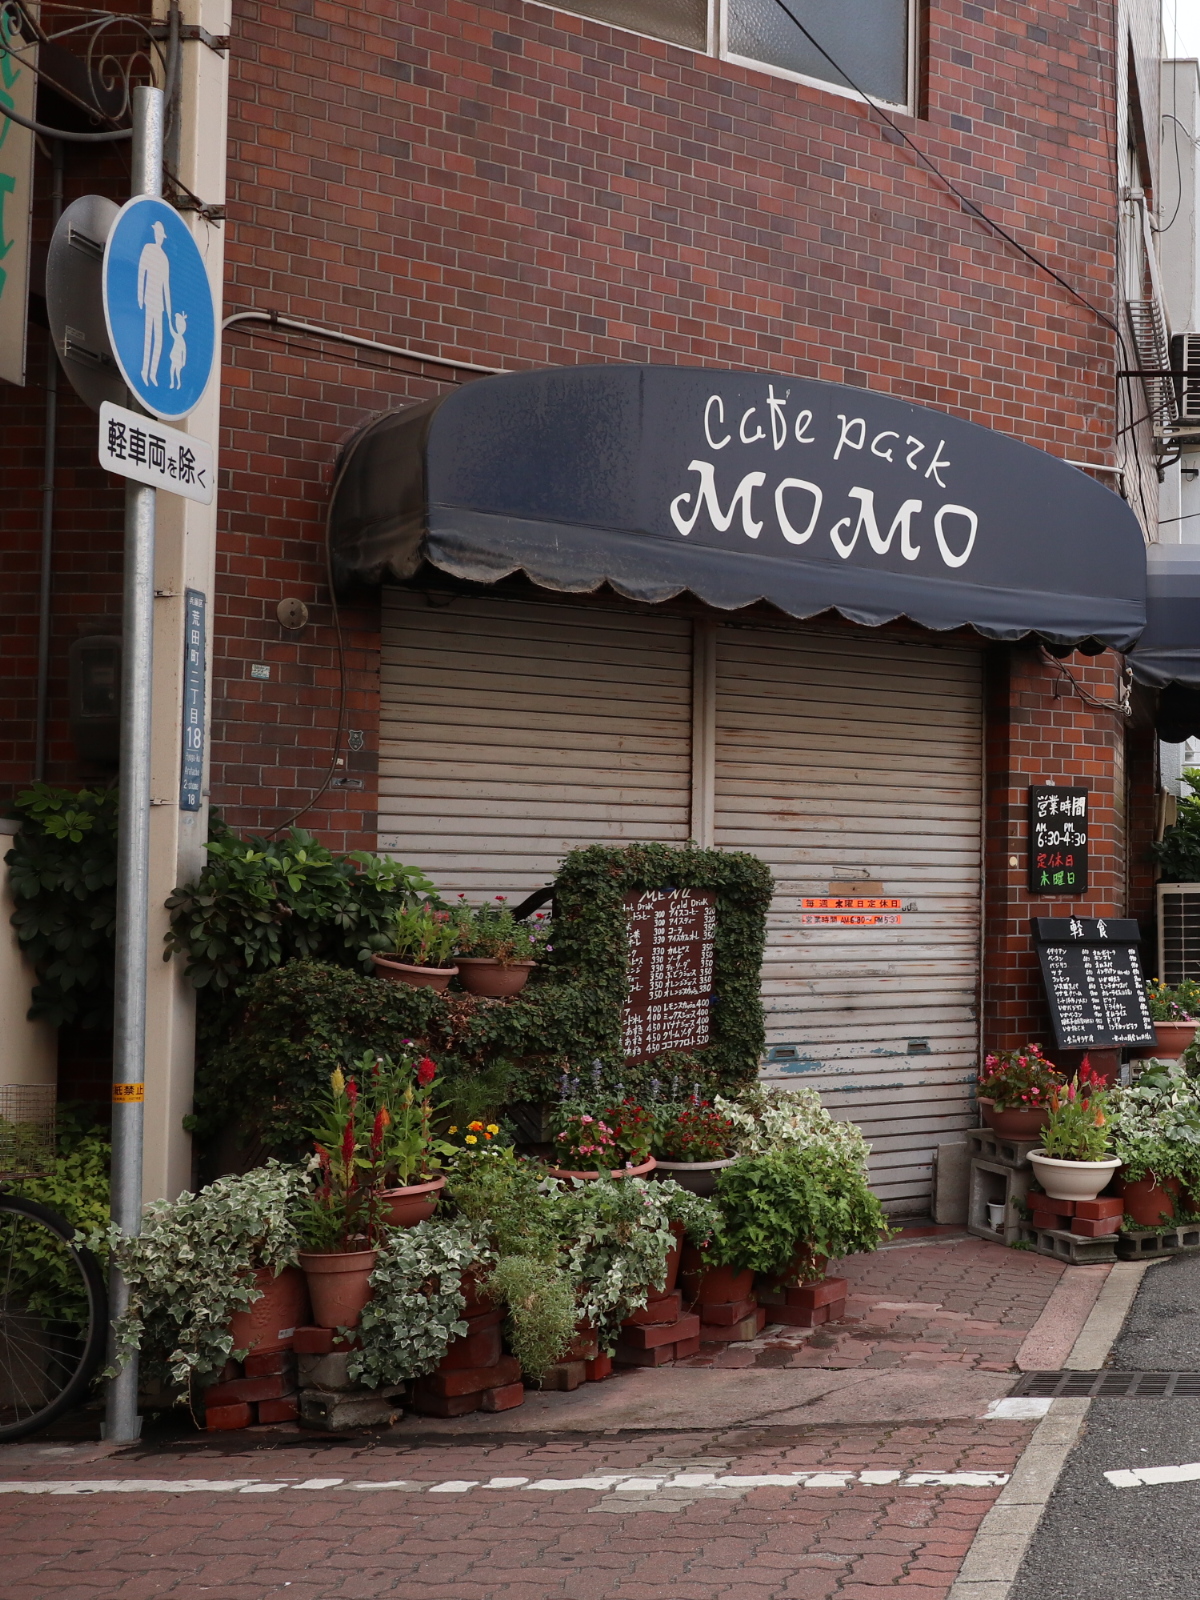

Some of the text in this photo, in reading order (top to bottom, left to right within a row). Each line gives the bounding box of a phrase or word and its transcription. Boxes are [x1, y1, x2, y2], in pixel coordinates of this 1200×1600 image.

[107, 418, 206, 488] 軽車両を除く
[833, 414, 951, 488] park
[669, 459, 978, 568] MOMO
[188, 794, 195, 805] 18
[1037, 794, 1086, 817] 営業時間
[1036, 852, 1074, 868] 定休日
[1040, 870, 1075, 886] 木曜日
[670, 899, 688, 910] Cold
[668, 926, 683, 934] コーラ
[652, 947, 664, 956] 330
[651, 956, 664, 964] 330
[651, 964, 664, 973] 330
[650, 973, 663, 982] 350
[649, 981, 663, 991] 350
[649, 990, 663, 1000] 350
[647, 1005, 662, 1013] 400
[647, 1013, 662, 1022] 400
